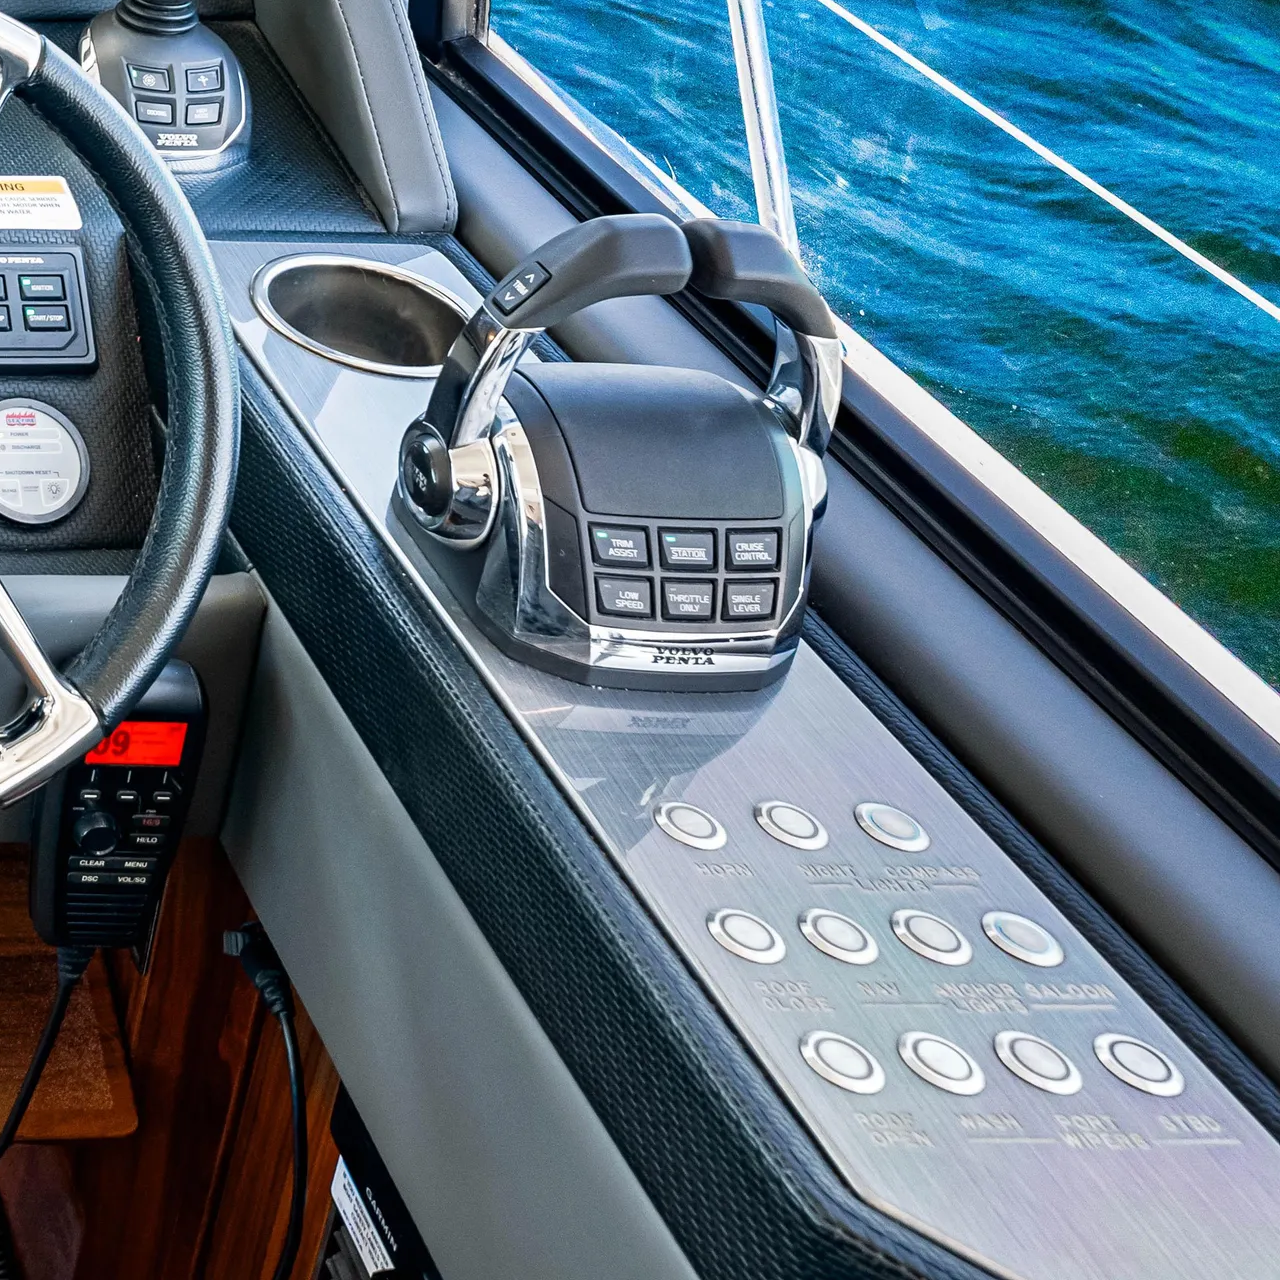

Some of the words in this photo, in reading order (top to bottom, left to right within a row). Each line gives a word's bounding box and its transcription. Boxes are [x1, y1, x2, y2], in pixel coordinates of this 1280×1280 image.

[611, 539, 633, 548] TRIM
[736, 543, 764, 551] CRUISE
[608, 549, 638, 558] ASSIST
[671, 549, 705, 558] STATION
[735, 552, 772, 561] CONTROL
[619, 591, 639, 600] LOW
[668, 594, 710, 604] THROTTLE
[732, 595, 760, 603] SINGLE
[615, 600, 644, 609] SPEED
[680, 604, 700, 612] ONLY
[734, 604, 761, 612] LEVER
[656, 647, 714, 655] VOLVO
[651, 656, 715, 665] PENTA
[695, 863, 755, 877] HORN
[366, 1187, 397, 1252] GARMIN
